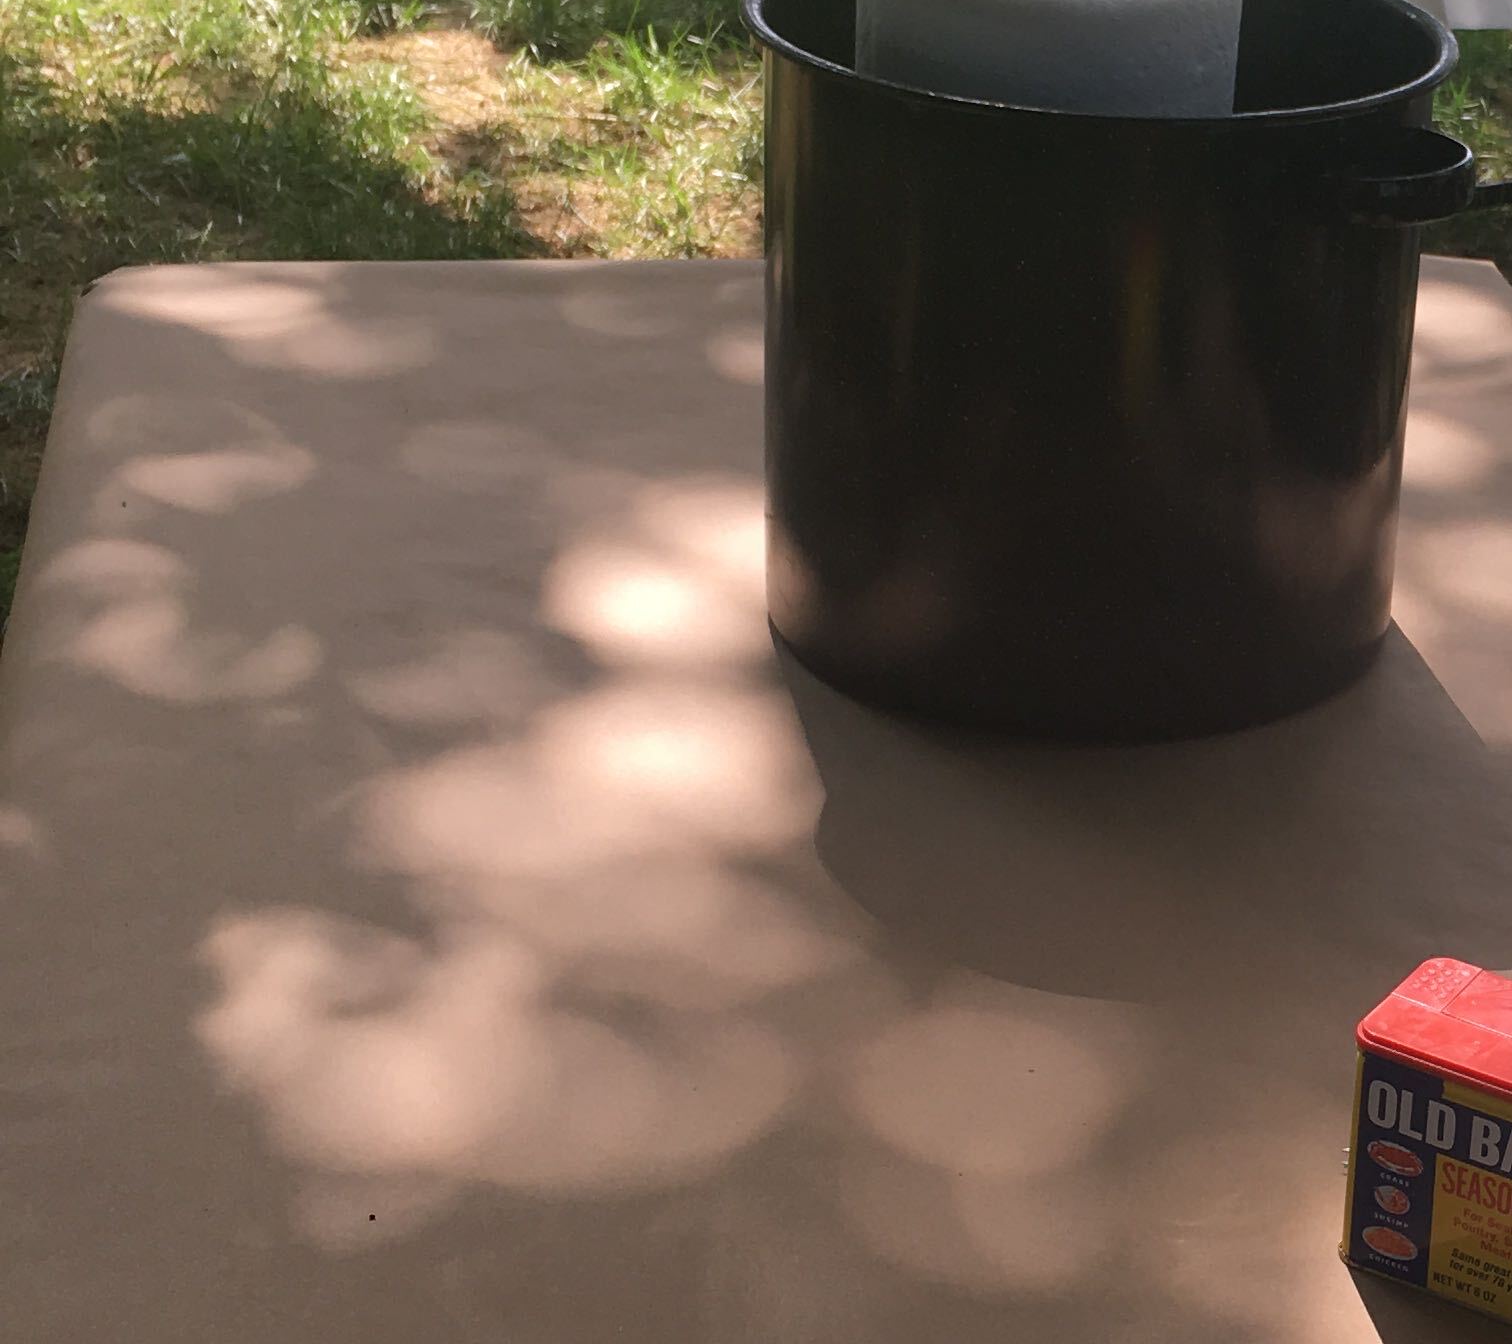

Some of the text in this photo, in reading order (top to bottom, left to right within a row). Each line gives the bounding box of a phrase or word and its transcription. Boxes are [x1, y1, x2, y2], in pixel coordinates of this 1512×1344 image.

[1367, 1079, 1457, 1151] OLD
[1463, 1207, 1483, 1222] For
[1449, 1258, 1464, 1272] for
[1466, 1267, 1489, 1281] over
[1451, 1247, 1481, 1267] Same
[1483, 1261, 1512, 1279] great
[1433, 1271, 1453, 1287] NET
[1455, 1279, 1472, 1294] WT
